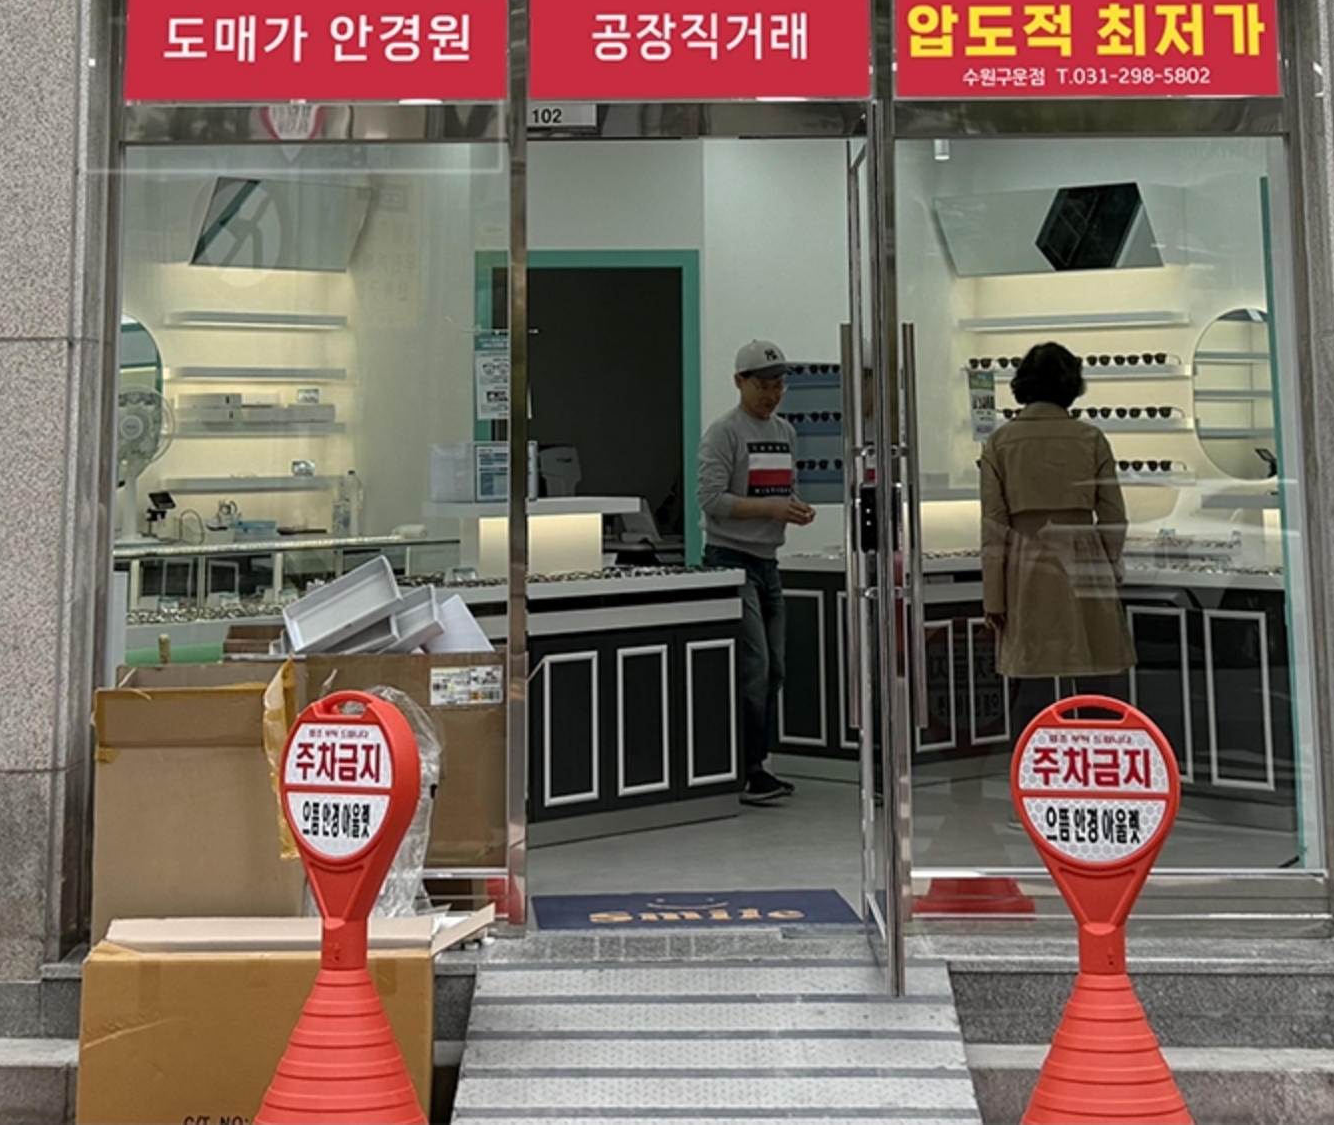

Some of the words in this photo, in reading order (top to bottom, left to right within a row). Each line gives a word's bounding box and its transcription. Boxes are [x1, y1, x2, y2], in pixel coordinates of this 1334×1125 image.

[164, 16, 307, 62] 도매가
[329, 14, 471, 62] 안경원
[591, 12, 808, 60] 공장직거래
[907, 4, 1072, 57] 압도적
[1097, 3, 1264, 56] 최저가
[963, 68, 1046, 86] 수원구운점
[531, 108, 563, 125] 102
[296, 742, 380, 783] 주차금지
[1033, 747, 1151, 788] 주차금지
[303, 801, 320, 835] 으뜸
[342, 803, 370, 838] 아울렛
[1047, 806, 1070, 842] 으뜸
[1074, 808, 1098, 843] 안경
[1102, 809, 1140, 844] 아울렛
